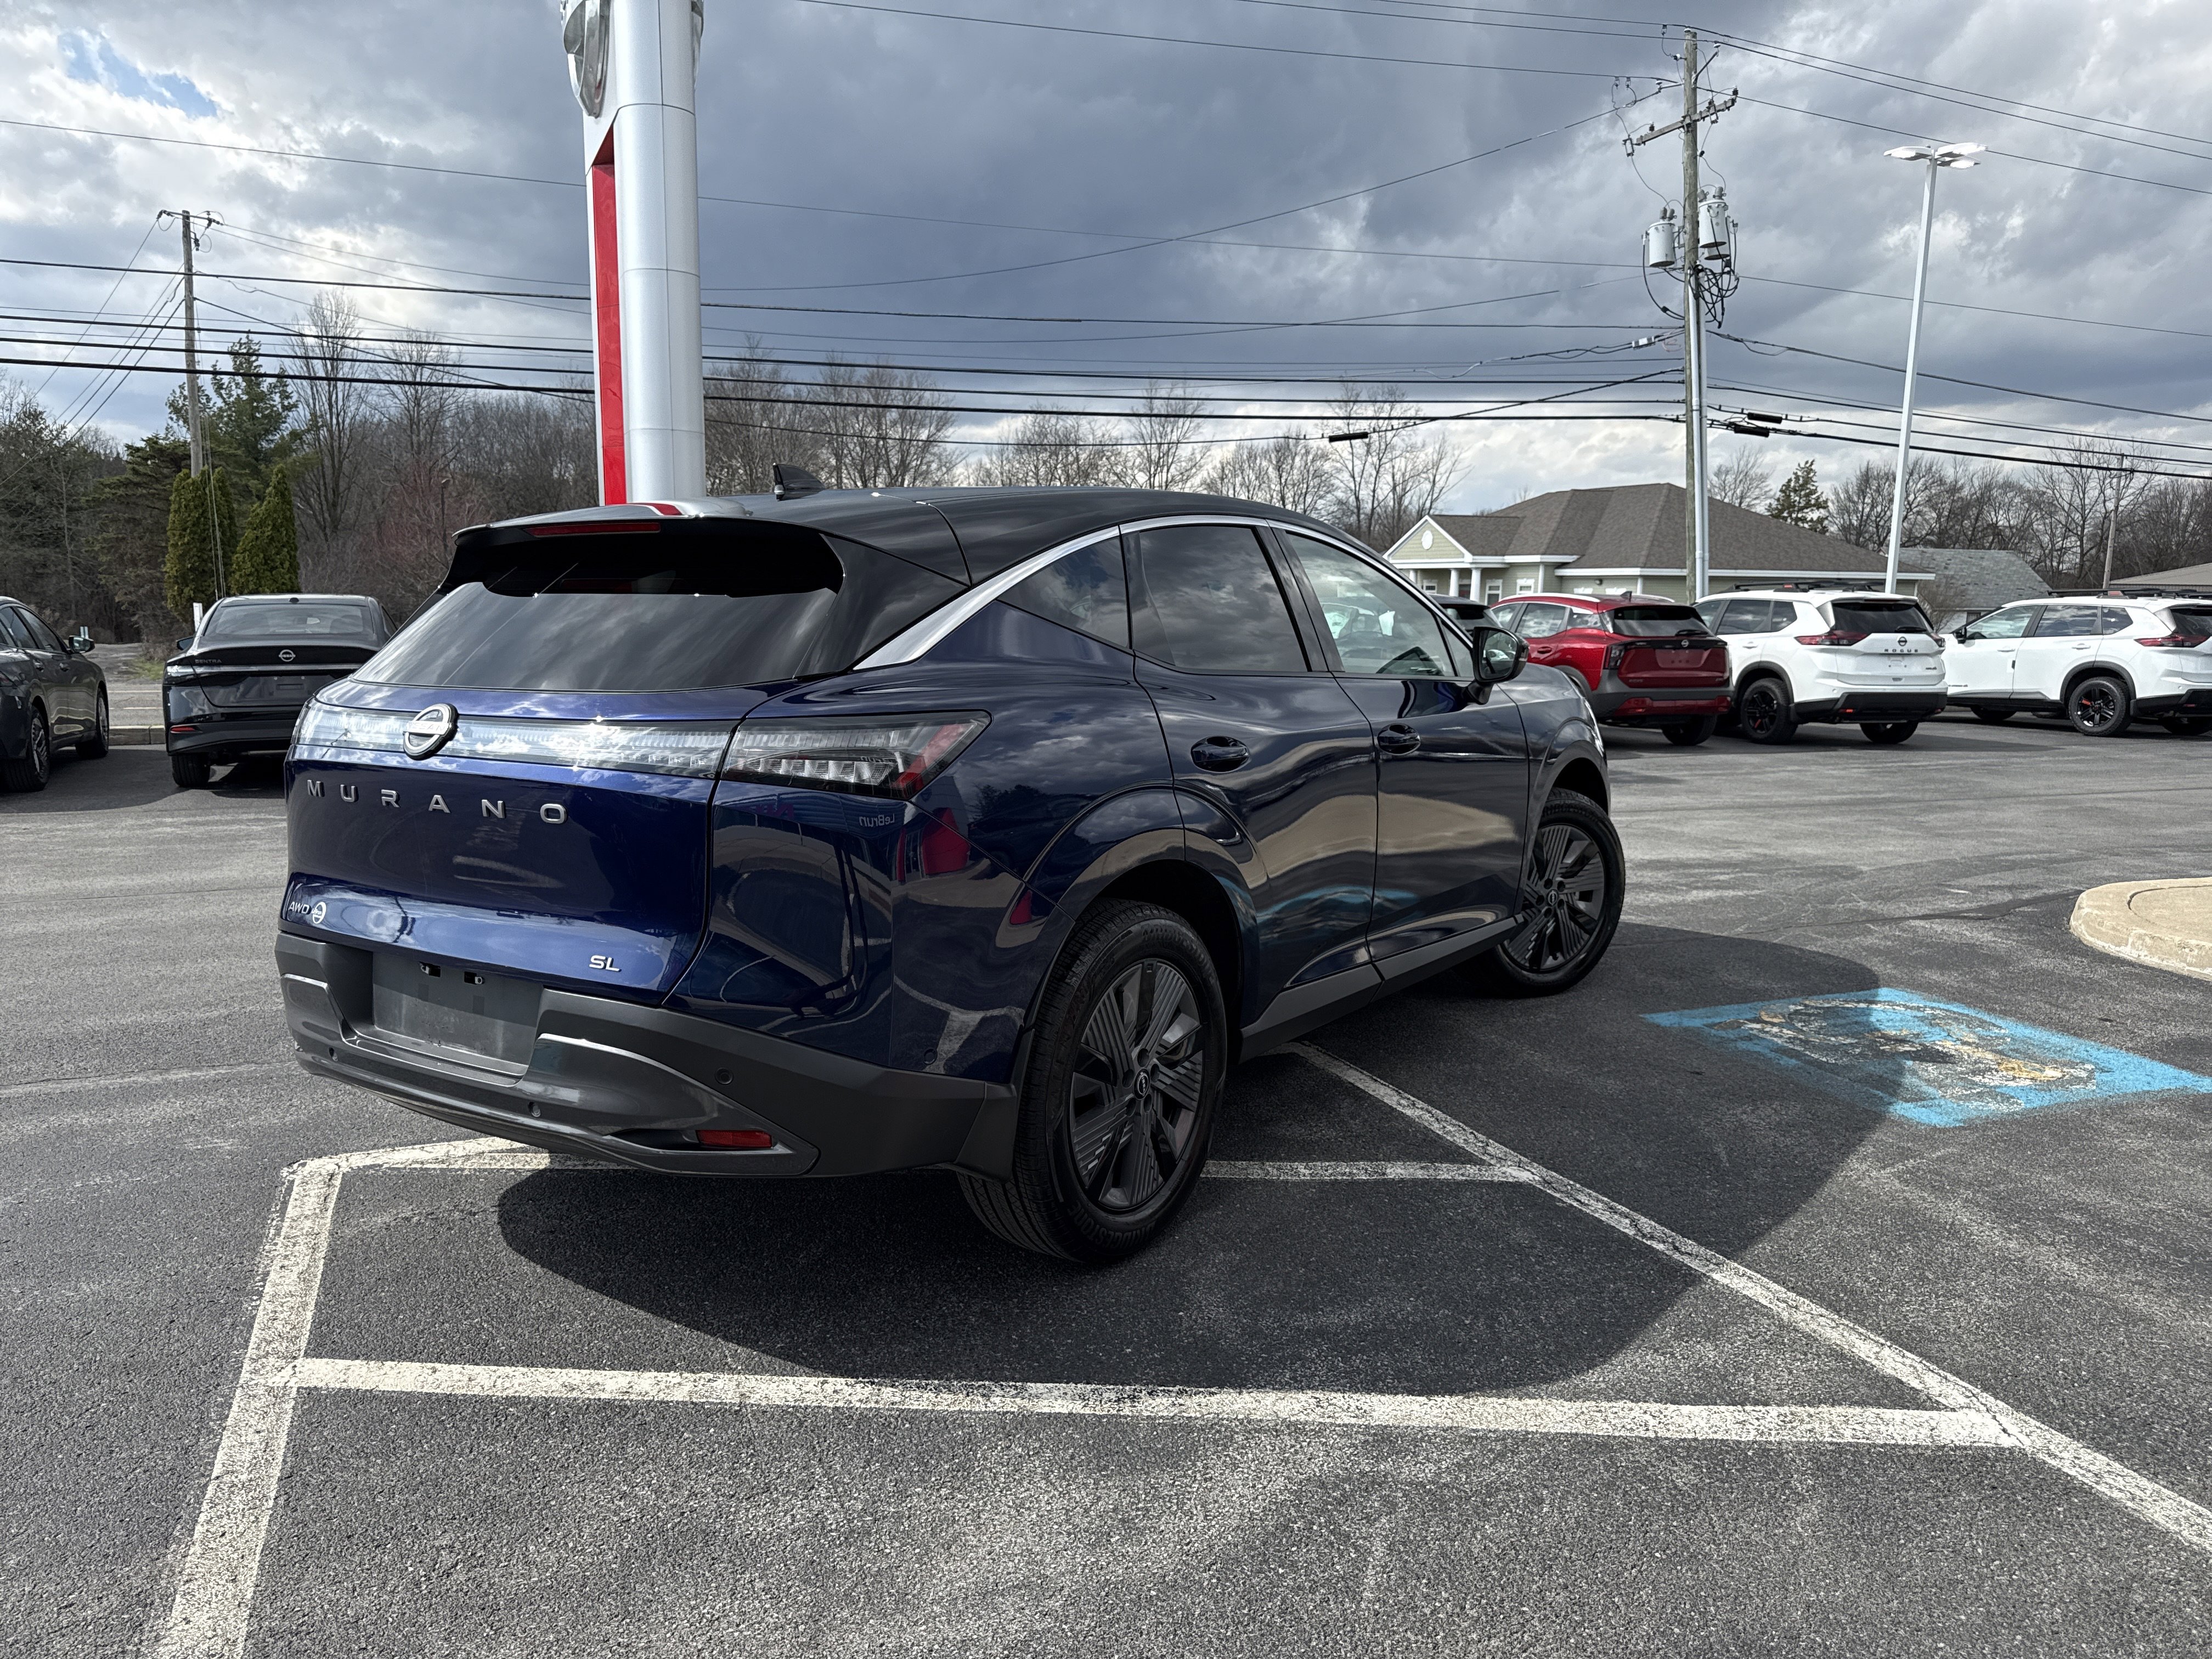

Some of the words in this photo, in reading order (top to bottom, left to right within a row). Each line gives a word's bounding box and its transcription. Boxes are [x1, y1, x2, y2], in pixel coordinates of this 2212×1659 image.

[407, 722, 447, 732] SSAN
[307, 780, 567, 824] MURANO
[288, 901, 311, 915] AWD
[589, 955, 620, 972] SL
